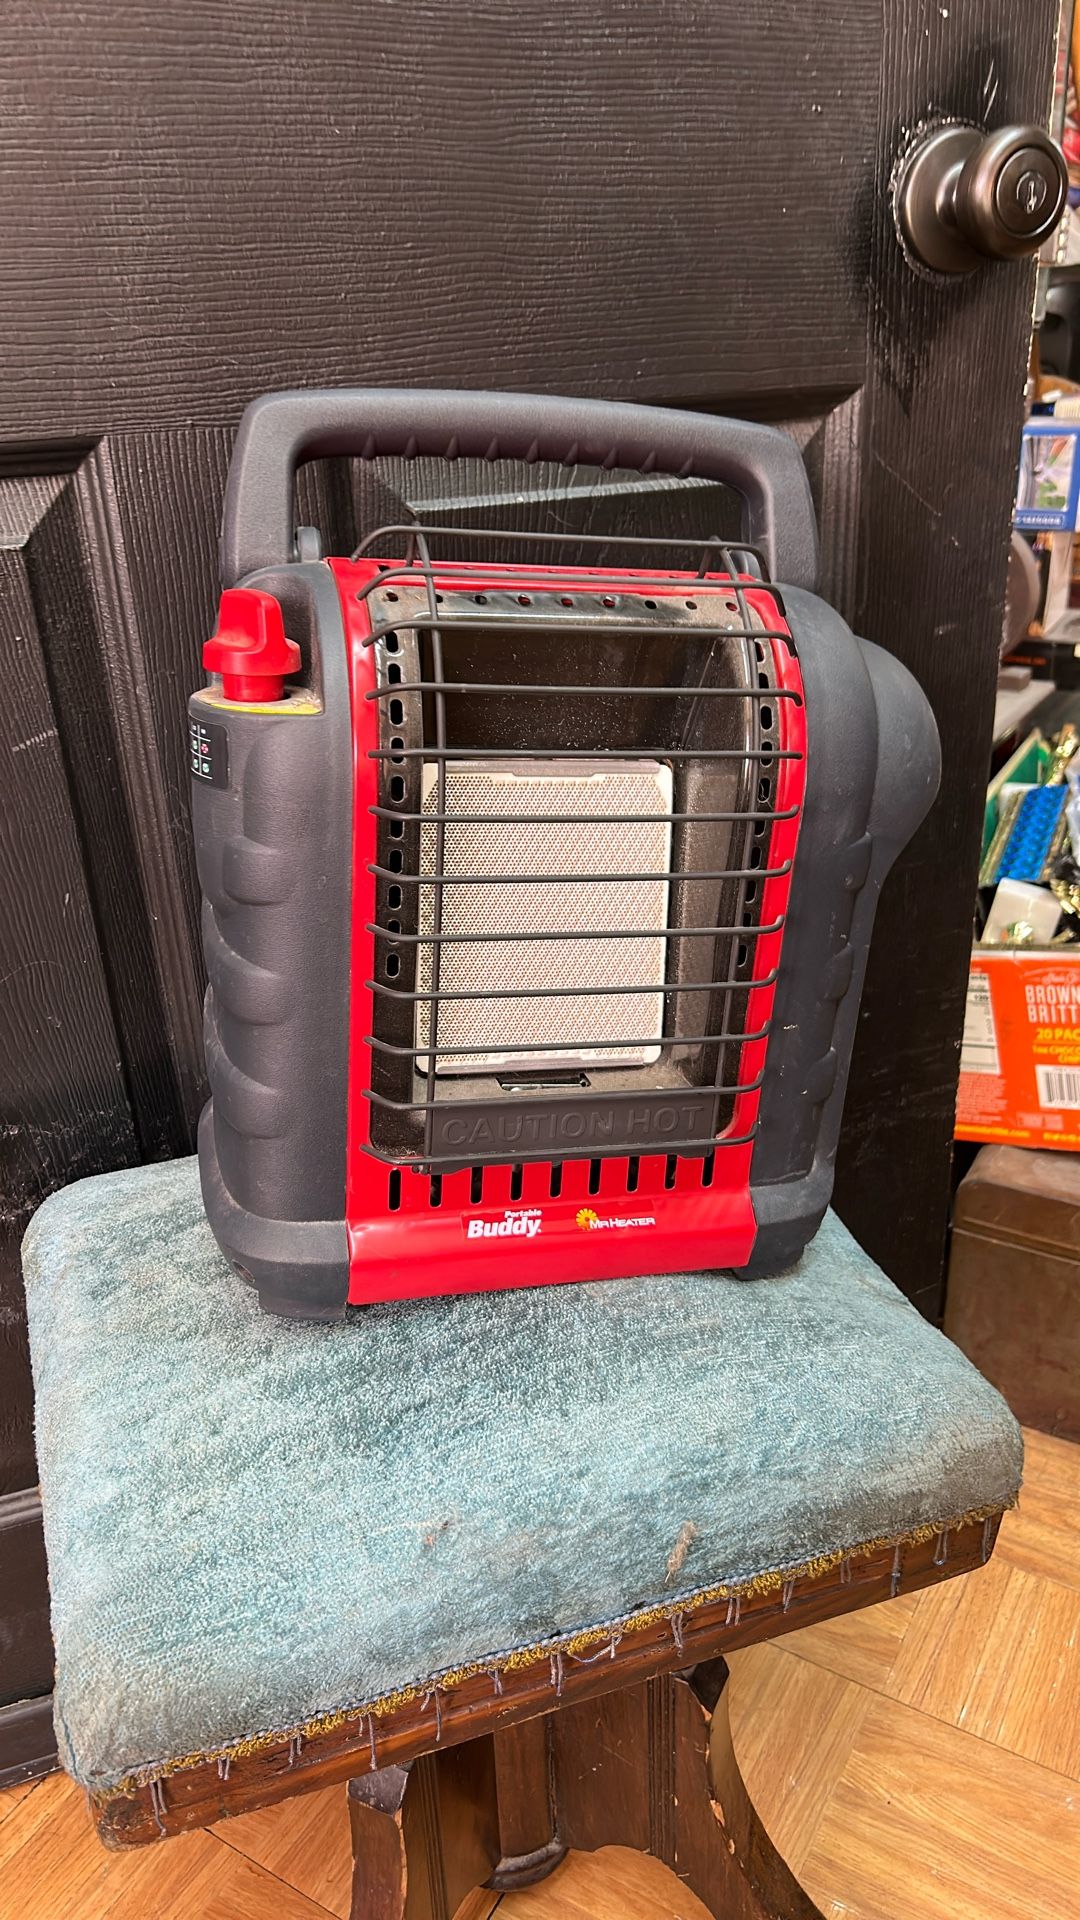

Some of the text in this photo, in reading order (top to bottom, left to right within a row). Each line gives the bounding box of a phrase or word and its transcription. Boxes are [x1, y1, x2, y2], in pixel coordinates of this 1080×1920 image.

[1036, 1028, 1053, 1040] 20
[441, 1105, 704, 1146] CAUTION HOT
[504, 1209, 542, 1219] Portable
[610, 1216, 656, 1228] HEATER
